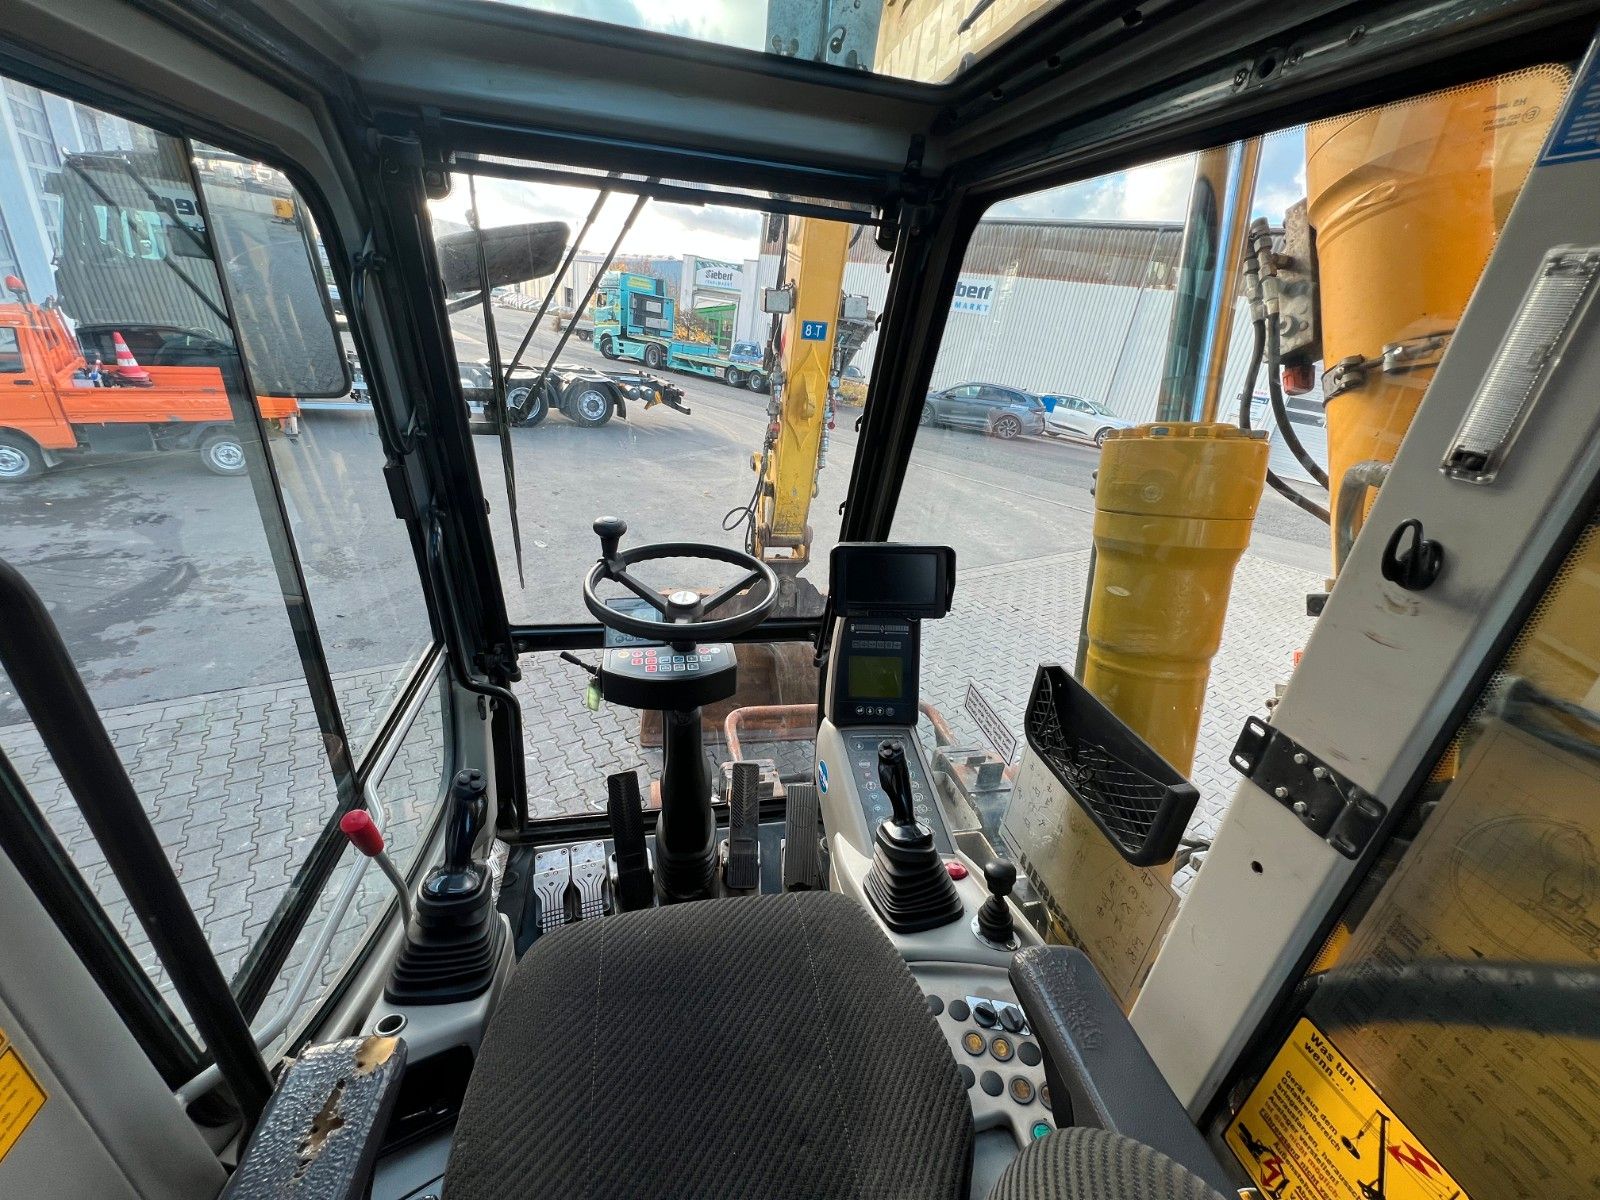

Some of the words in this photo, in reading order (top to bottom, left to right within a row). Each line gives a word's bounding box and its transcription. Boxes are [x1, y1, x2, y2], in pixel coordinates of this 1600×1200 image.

[705, 269, 734, 281] Siebert
[955, 282, 993, 299] bert
[954, 301, 989, 312] MARKT
[805, 324, 812, 337] 8
[816, 324, 823, 337] T
[1311, 1032, 1335, 1063] Was
[1268, 1096, 1299, 1134] Ausleger
[1281, 1076, 1341, 1152] Gefahrenbereich
[1305, 1096, 1320, 1113] aus
[1320, 1113, 1338, 1136] dem
[1289, 1133, 1308, 1158] nicht
[1300, 1161, 1320, 1186] nicht
[1321, 1152, 1361, 1200] heraussc
